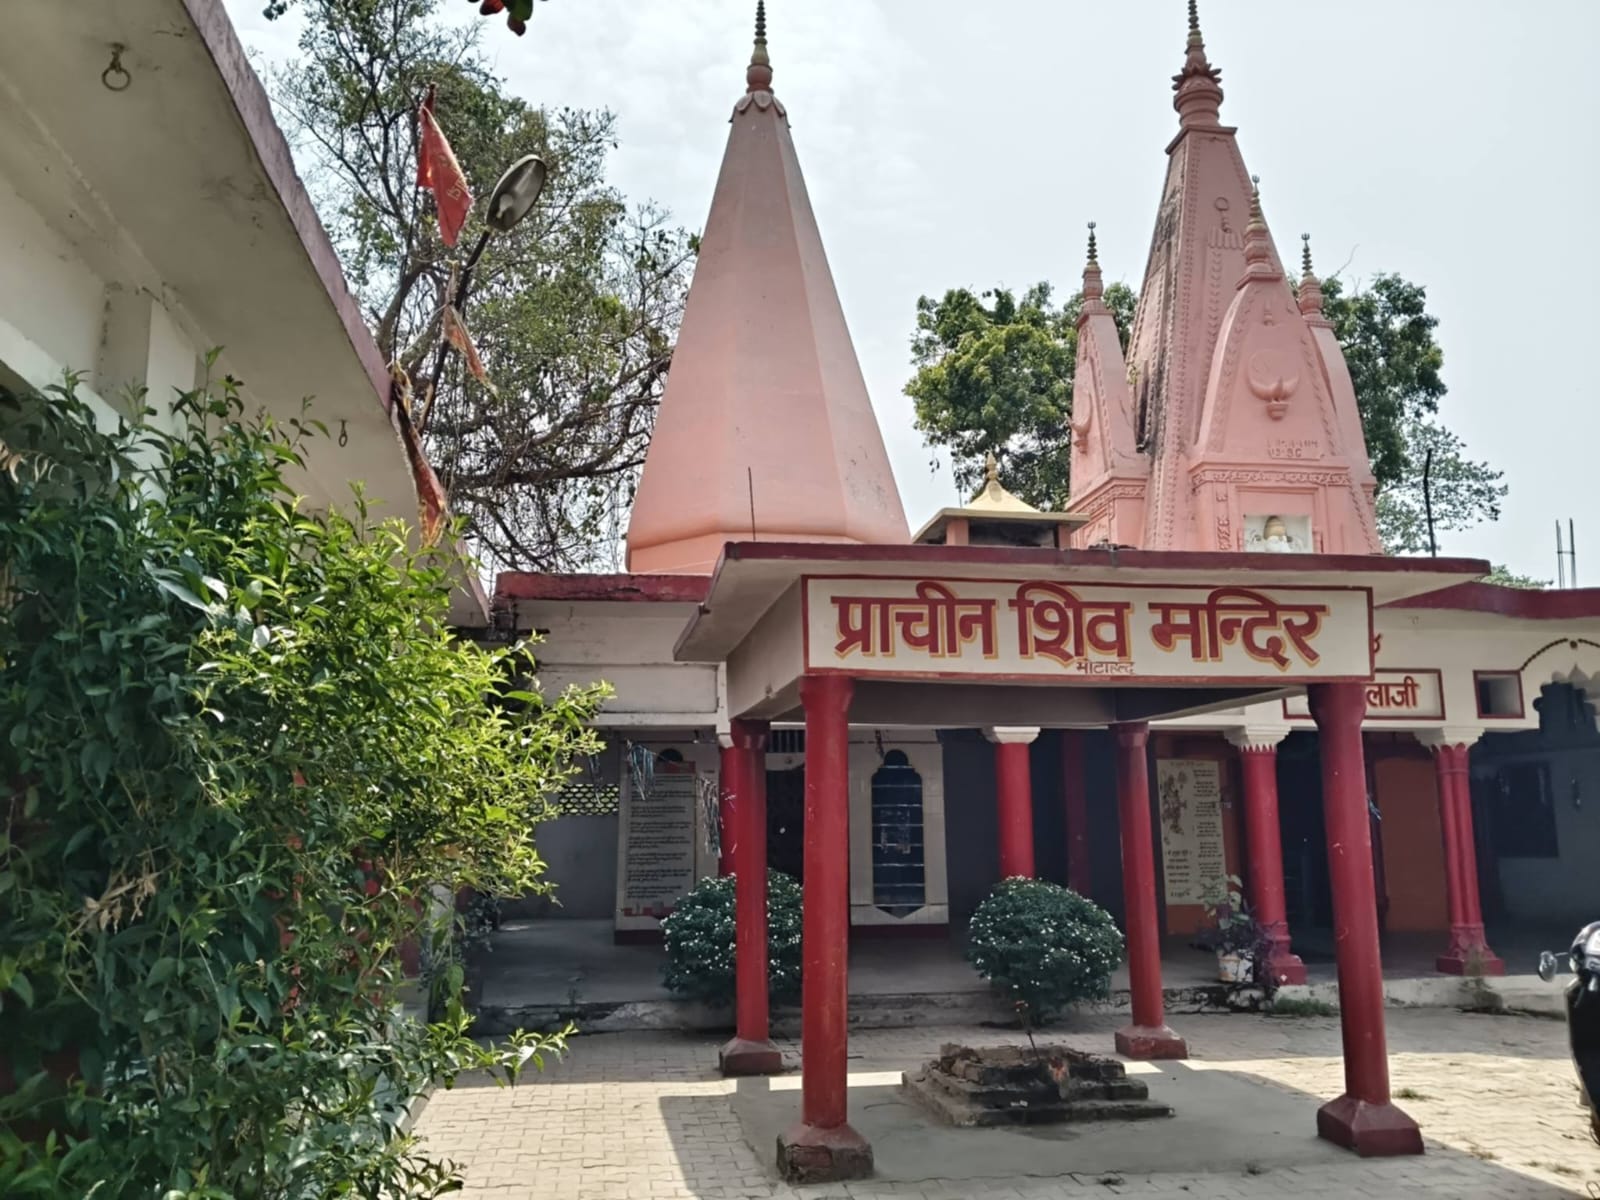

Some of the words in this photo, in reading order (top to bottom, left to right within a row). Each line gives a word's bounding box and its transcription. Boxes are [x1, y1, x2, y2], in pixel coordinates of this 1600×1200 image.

[830, 581, 998, 657] प्राचीन
[1008, 581, 1134, 663] शिव
[1148, 586, 1331, 672] मन्दिर
[1364, 675, 1420, 707] लाजी
